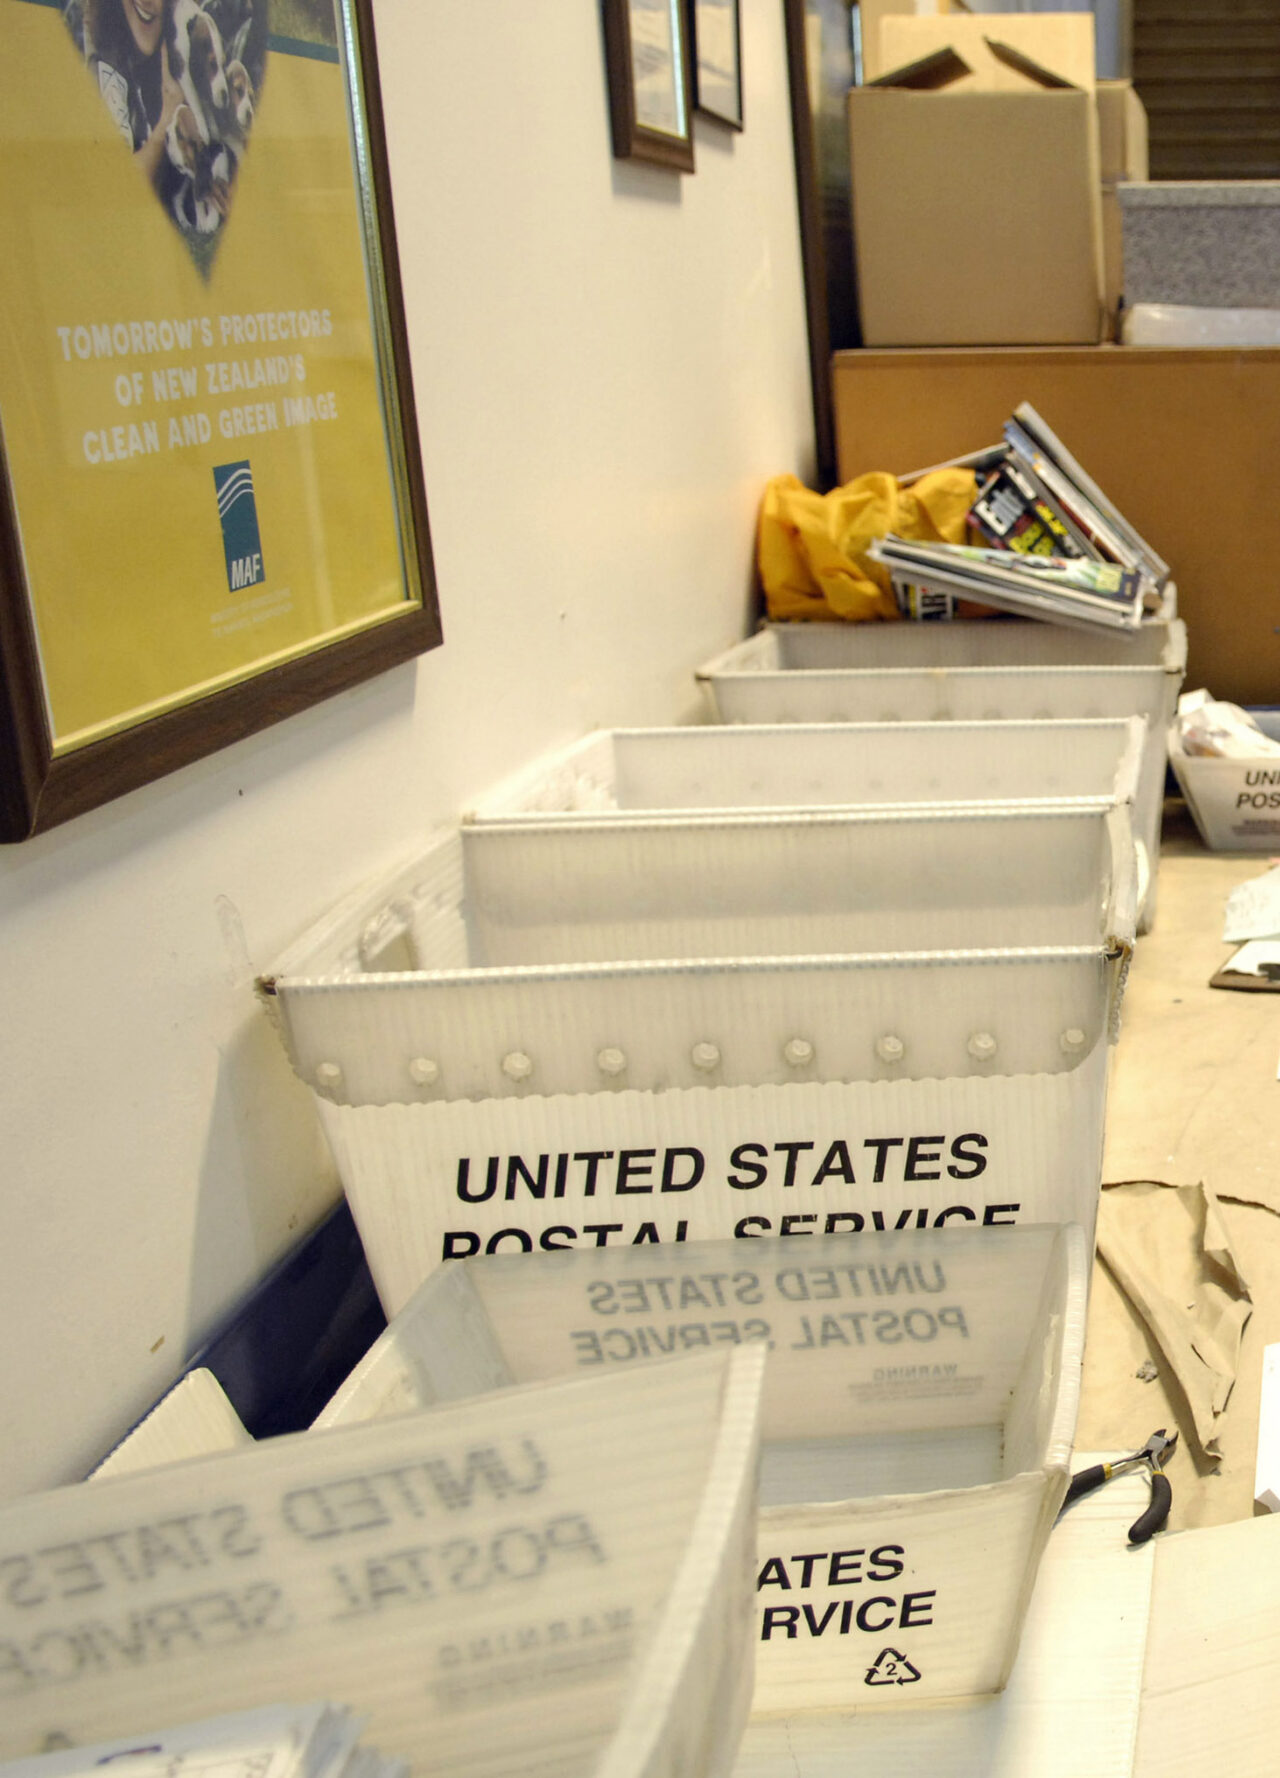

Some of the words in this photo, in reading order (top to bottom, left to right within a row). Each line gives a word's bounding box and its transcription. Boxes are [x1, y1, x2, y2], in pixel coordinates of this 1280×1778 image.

[56, 316, 213, 361] TOMORROW'S
[220, 309, 332, 346] PROTECTORS
[115, 372, 143, 407] OF
[152, 366, 197, 402] NEW
[205, 353, 306, 394] ZEALAND'S
[83, 420, 161, 464] CLEAN
[168, 412, 212, 449] AND
[219, 402, 279, 439] GREEN
[283, 391, 338, 427] IMAGE
[231, 553, 260, 589] MAF
[455, 1147, 705, 1203] UNITED
[727, 1132, 990, 1190] STATES
[757, 1544, 905, 1592] ATES
[761, 1589, 937, 1640] RVICE
[885, 1662, 898, 1676] 2
